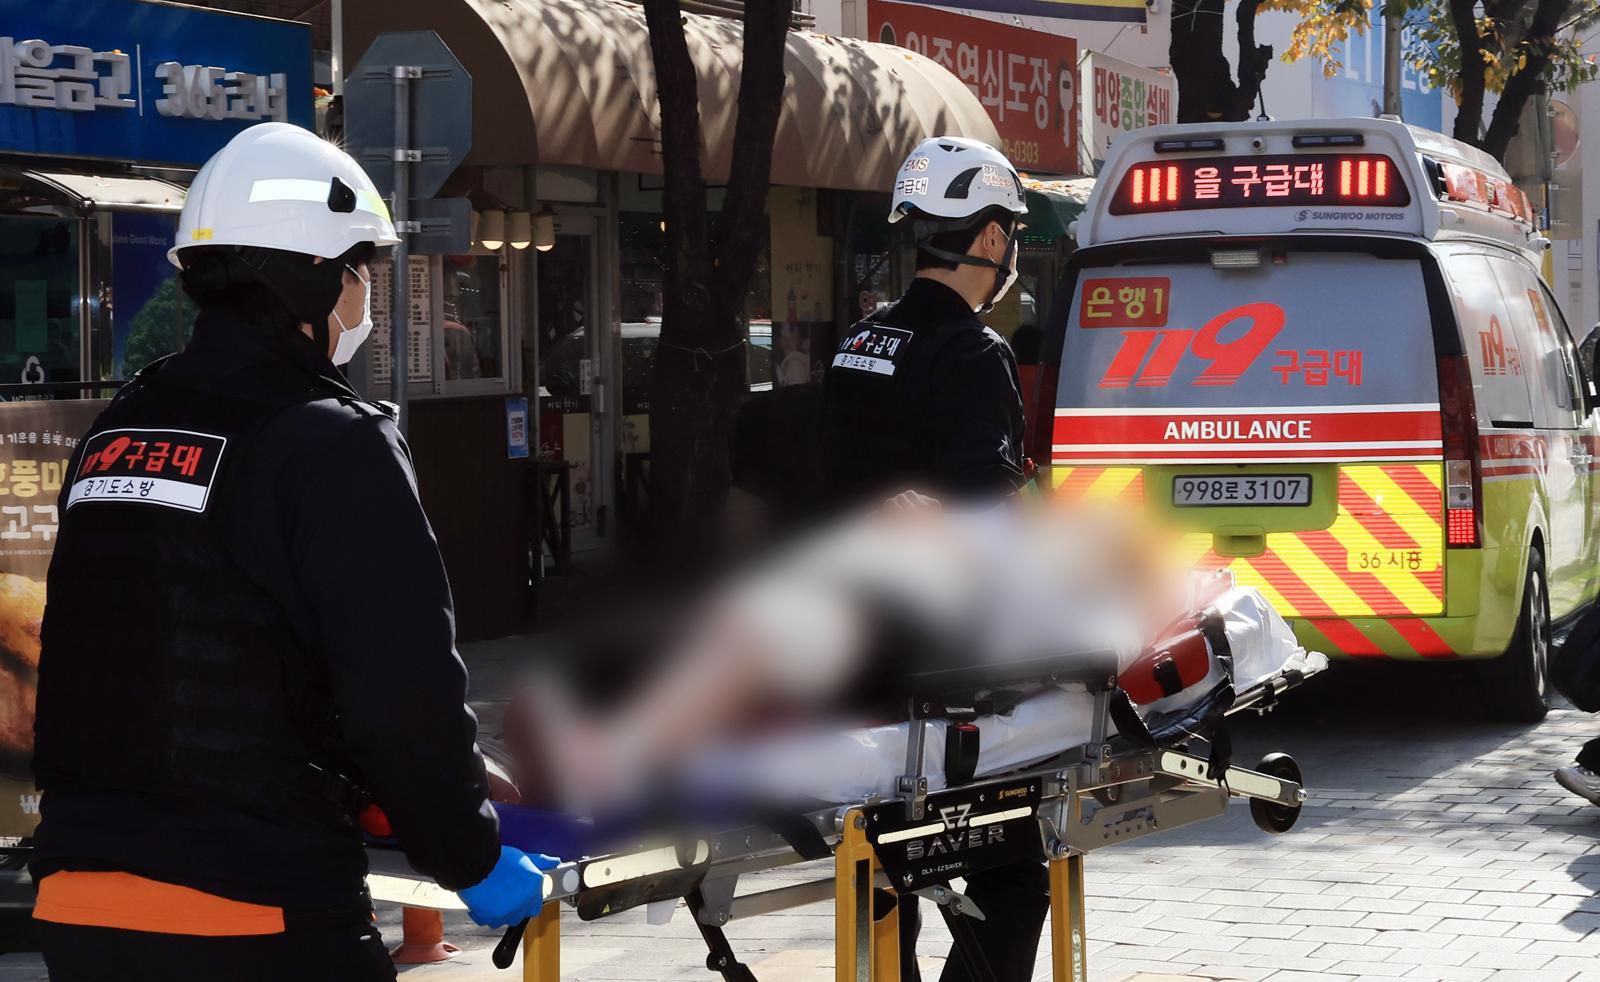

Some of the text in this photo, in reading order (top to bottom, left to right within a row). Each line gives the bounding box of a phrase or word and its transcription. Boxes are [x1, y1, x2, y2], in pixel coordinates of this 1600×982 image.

[0, 36, 286, 122] 을금고 365코너
[904, 158, 928, 172] EMS
[897, 178, 927, 194] 구급대
[1194, 163, 1324, 199] 을 구급대
[1312, 211, 1405, 221] SUNGWOO MOTORS
[1087, 286, 1164, 319] 은행1
[1098, 302, 1363, 389] 119 구급대
[840, 354, 877, 371] 경기도소방
[1163, 420, 1312, 440] AMBULANCE
[84, 479, 154, 497] 경기도소방
[1182, 480, 1301, 501] 998로 3107
[1360, 550, 1422, 570] 36 시흥
[906, 825, 1006, 861] SAVER
